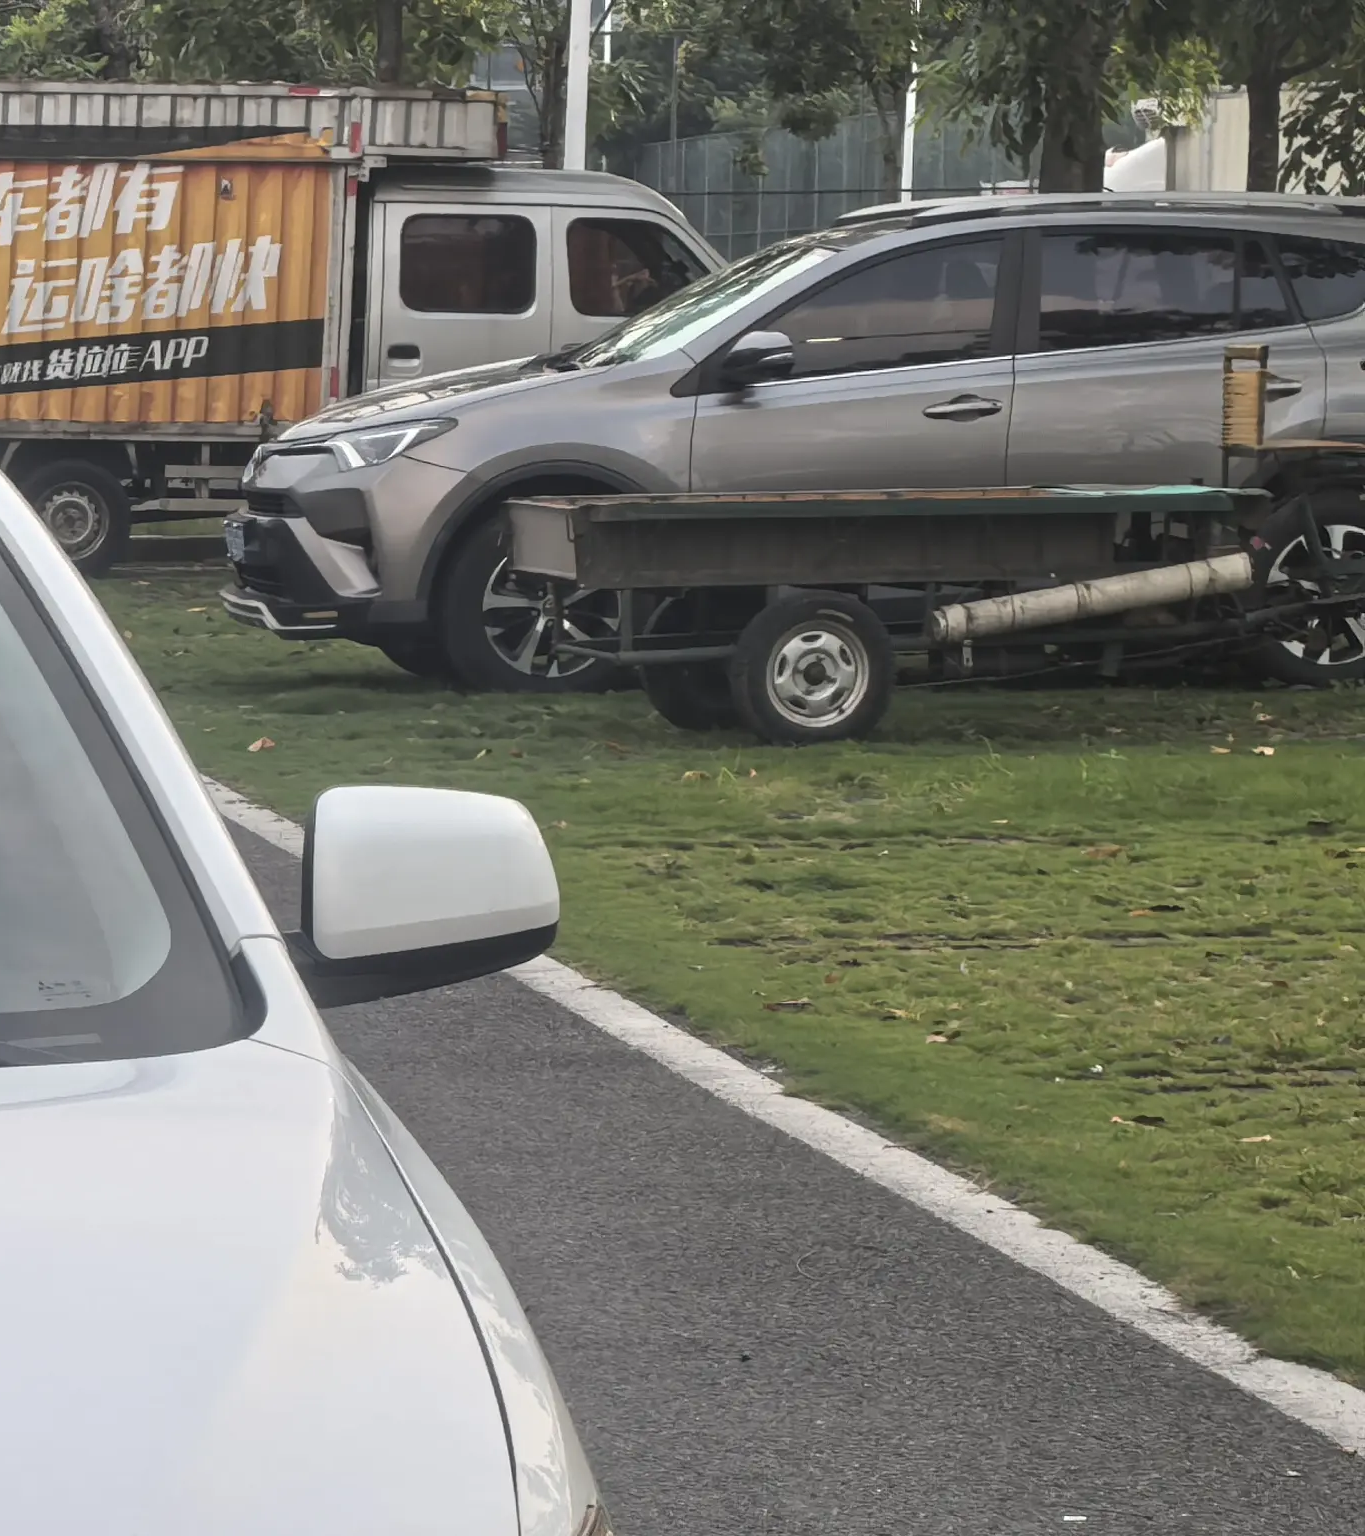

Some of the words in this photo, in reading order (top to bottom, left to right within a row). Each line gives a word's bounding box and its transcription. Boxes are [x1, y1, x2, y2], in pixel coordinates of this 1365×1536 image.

[0, 235, 283, 334] 运啥都快
[139, 336, 209, 372] APP
